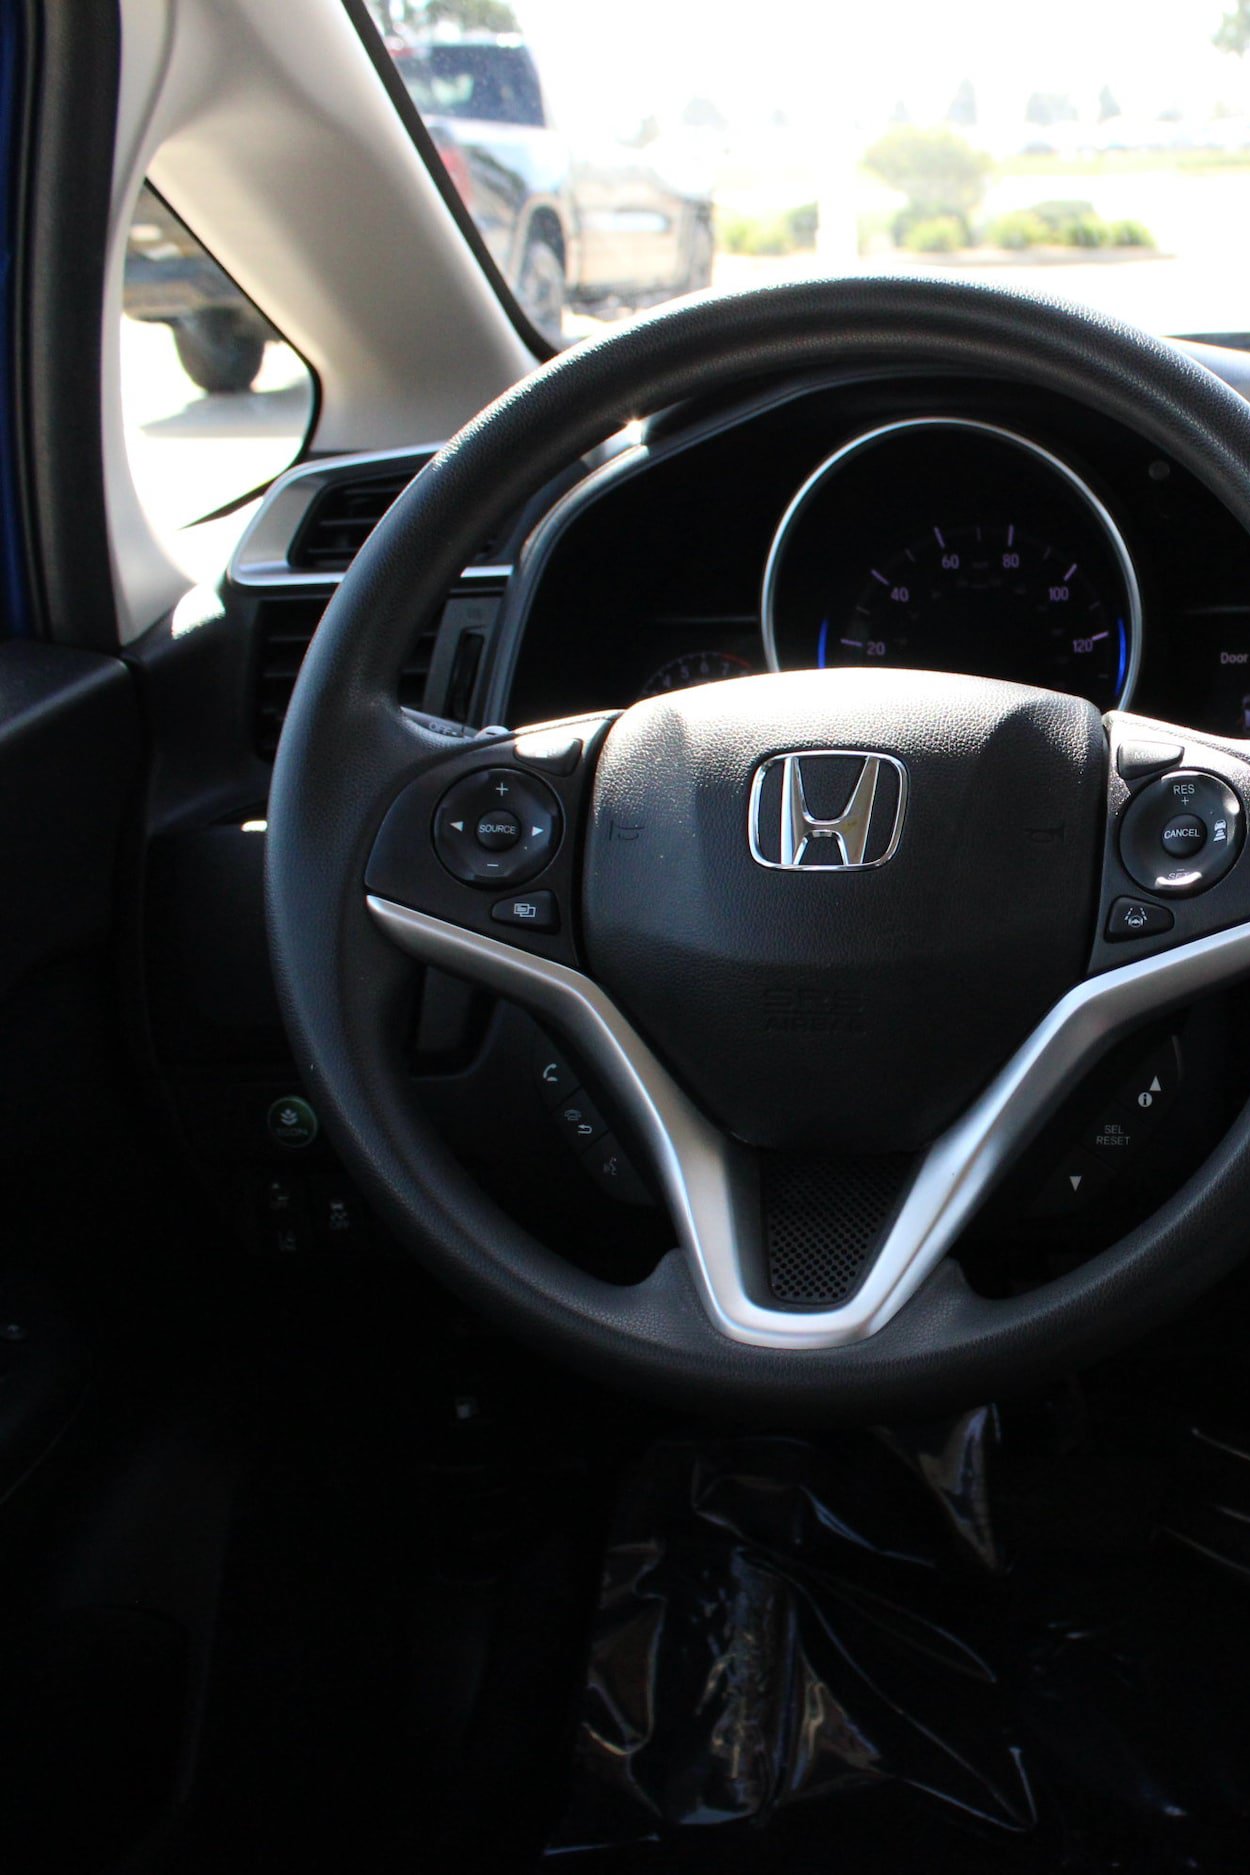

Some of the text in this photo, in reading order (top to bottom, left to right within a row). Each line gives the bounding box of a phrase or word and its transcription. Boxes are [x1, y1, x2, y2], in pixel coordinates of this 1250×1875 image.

[941, 554, 960, 569] 60
[1002, 554, 1019, 569] 80
[890, 587, 910, 602] 40
[1048, 587, 1069, 601] 100
[867, 641, 886, 655] 20
[1073, 639, 1093, 653] 120
[1220, 651, 1249, 665] Door
[1173, 784, 1195, 795] RES
[478, 824, 516, 836] SOURCE
[1163, 828, 1201, 840] CANCEL
[1103, 1124, 1124, 1135] SEL
[1096, 1136, 1131, 1146] RESET
